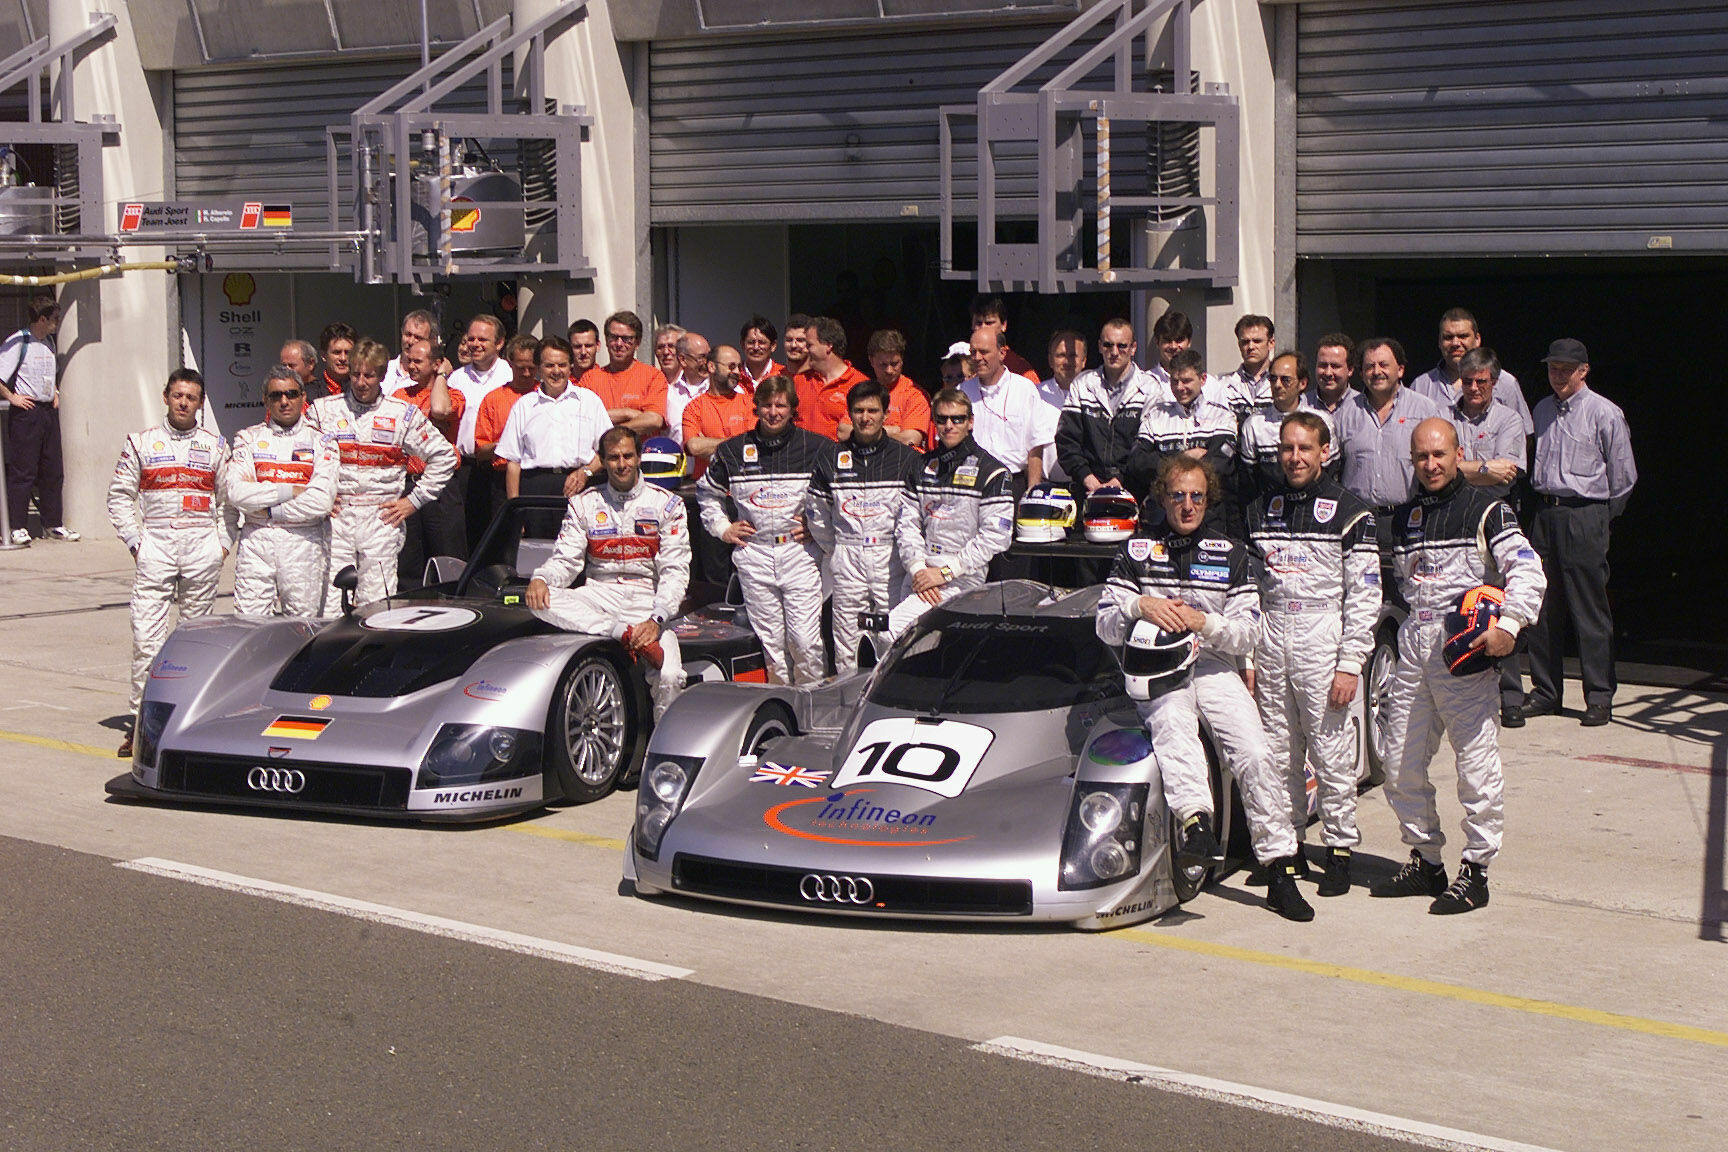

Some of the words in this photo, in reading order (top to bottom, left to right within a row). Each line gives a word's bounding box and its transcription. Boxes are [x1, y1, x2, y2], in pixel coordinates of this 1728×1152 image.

[144, 207, 163, 216] Audi
[165, 207, 189, 217] Sport
[142, 218, 163, 226] Team
[164, 218, 188, 226] Joest
[220, 311, 261, 323] Shell
[224, 401, 264, 409] MICHELIN
[155, 474, 177, 483] Audi
[178, 473, 204, 484] Sport
[276, 469, 304, 479] Sport
[602, 545, 623, 554] Audi
[623, 545, 650, 555] Sport
[1190, 568, 1230, 578] OLYMPUS
[402, 610, 449, 625] 7
[947, 621, 993, 629] Audi
[995, 622, 1049, 633] Sport
[857, 741, 961, 782] 10
[433, 787, 523, 804] MICHELIN
[811, 819, 929, 835] technologies
